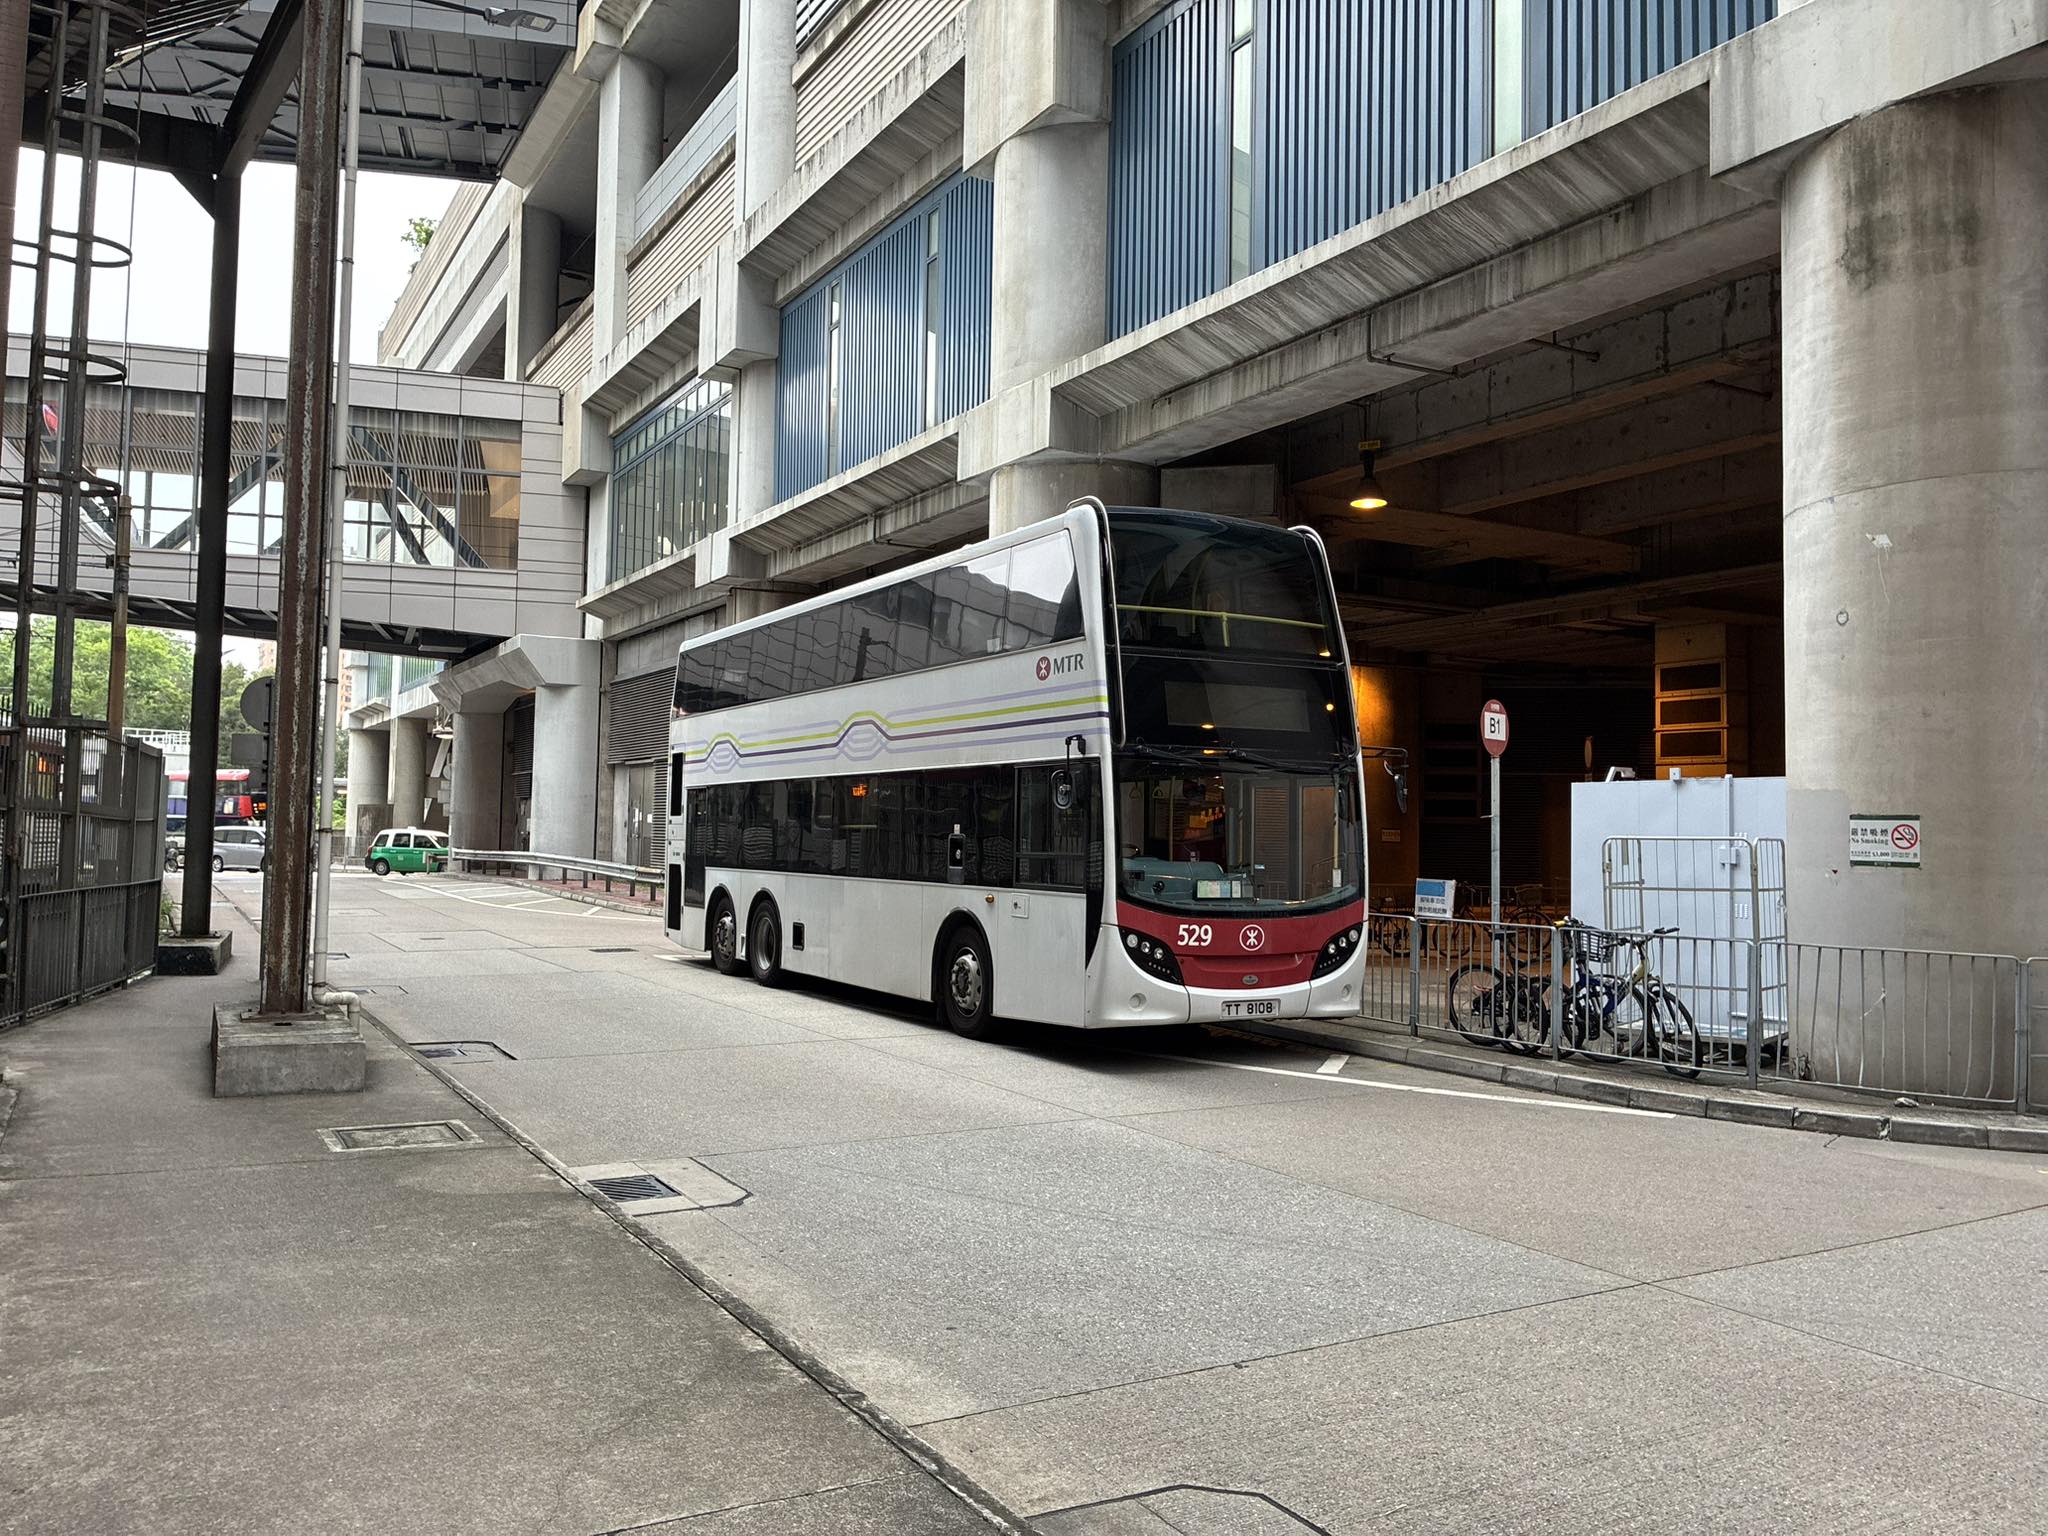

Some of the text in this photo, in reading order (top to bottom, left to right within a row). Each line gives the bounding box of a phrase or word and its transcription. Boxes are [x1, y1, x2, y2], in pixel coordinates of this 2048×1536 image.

[1053, 653, 1084, 675] MTR
[1490, 717, 1500, 735] B1
[1861, 837, 1888, 846] Smoking
[1177, 924, 1213, 946] 529
[1225, 1002, 1273, 1016] TT 8108
